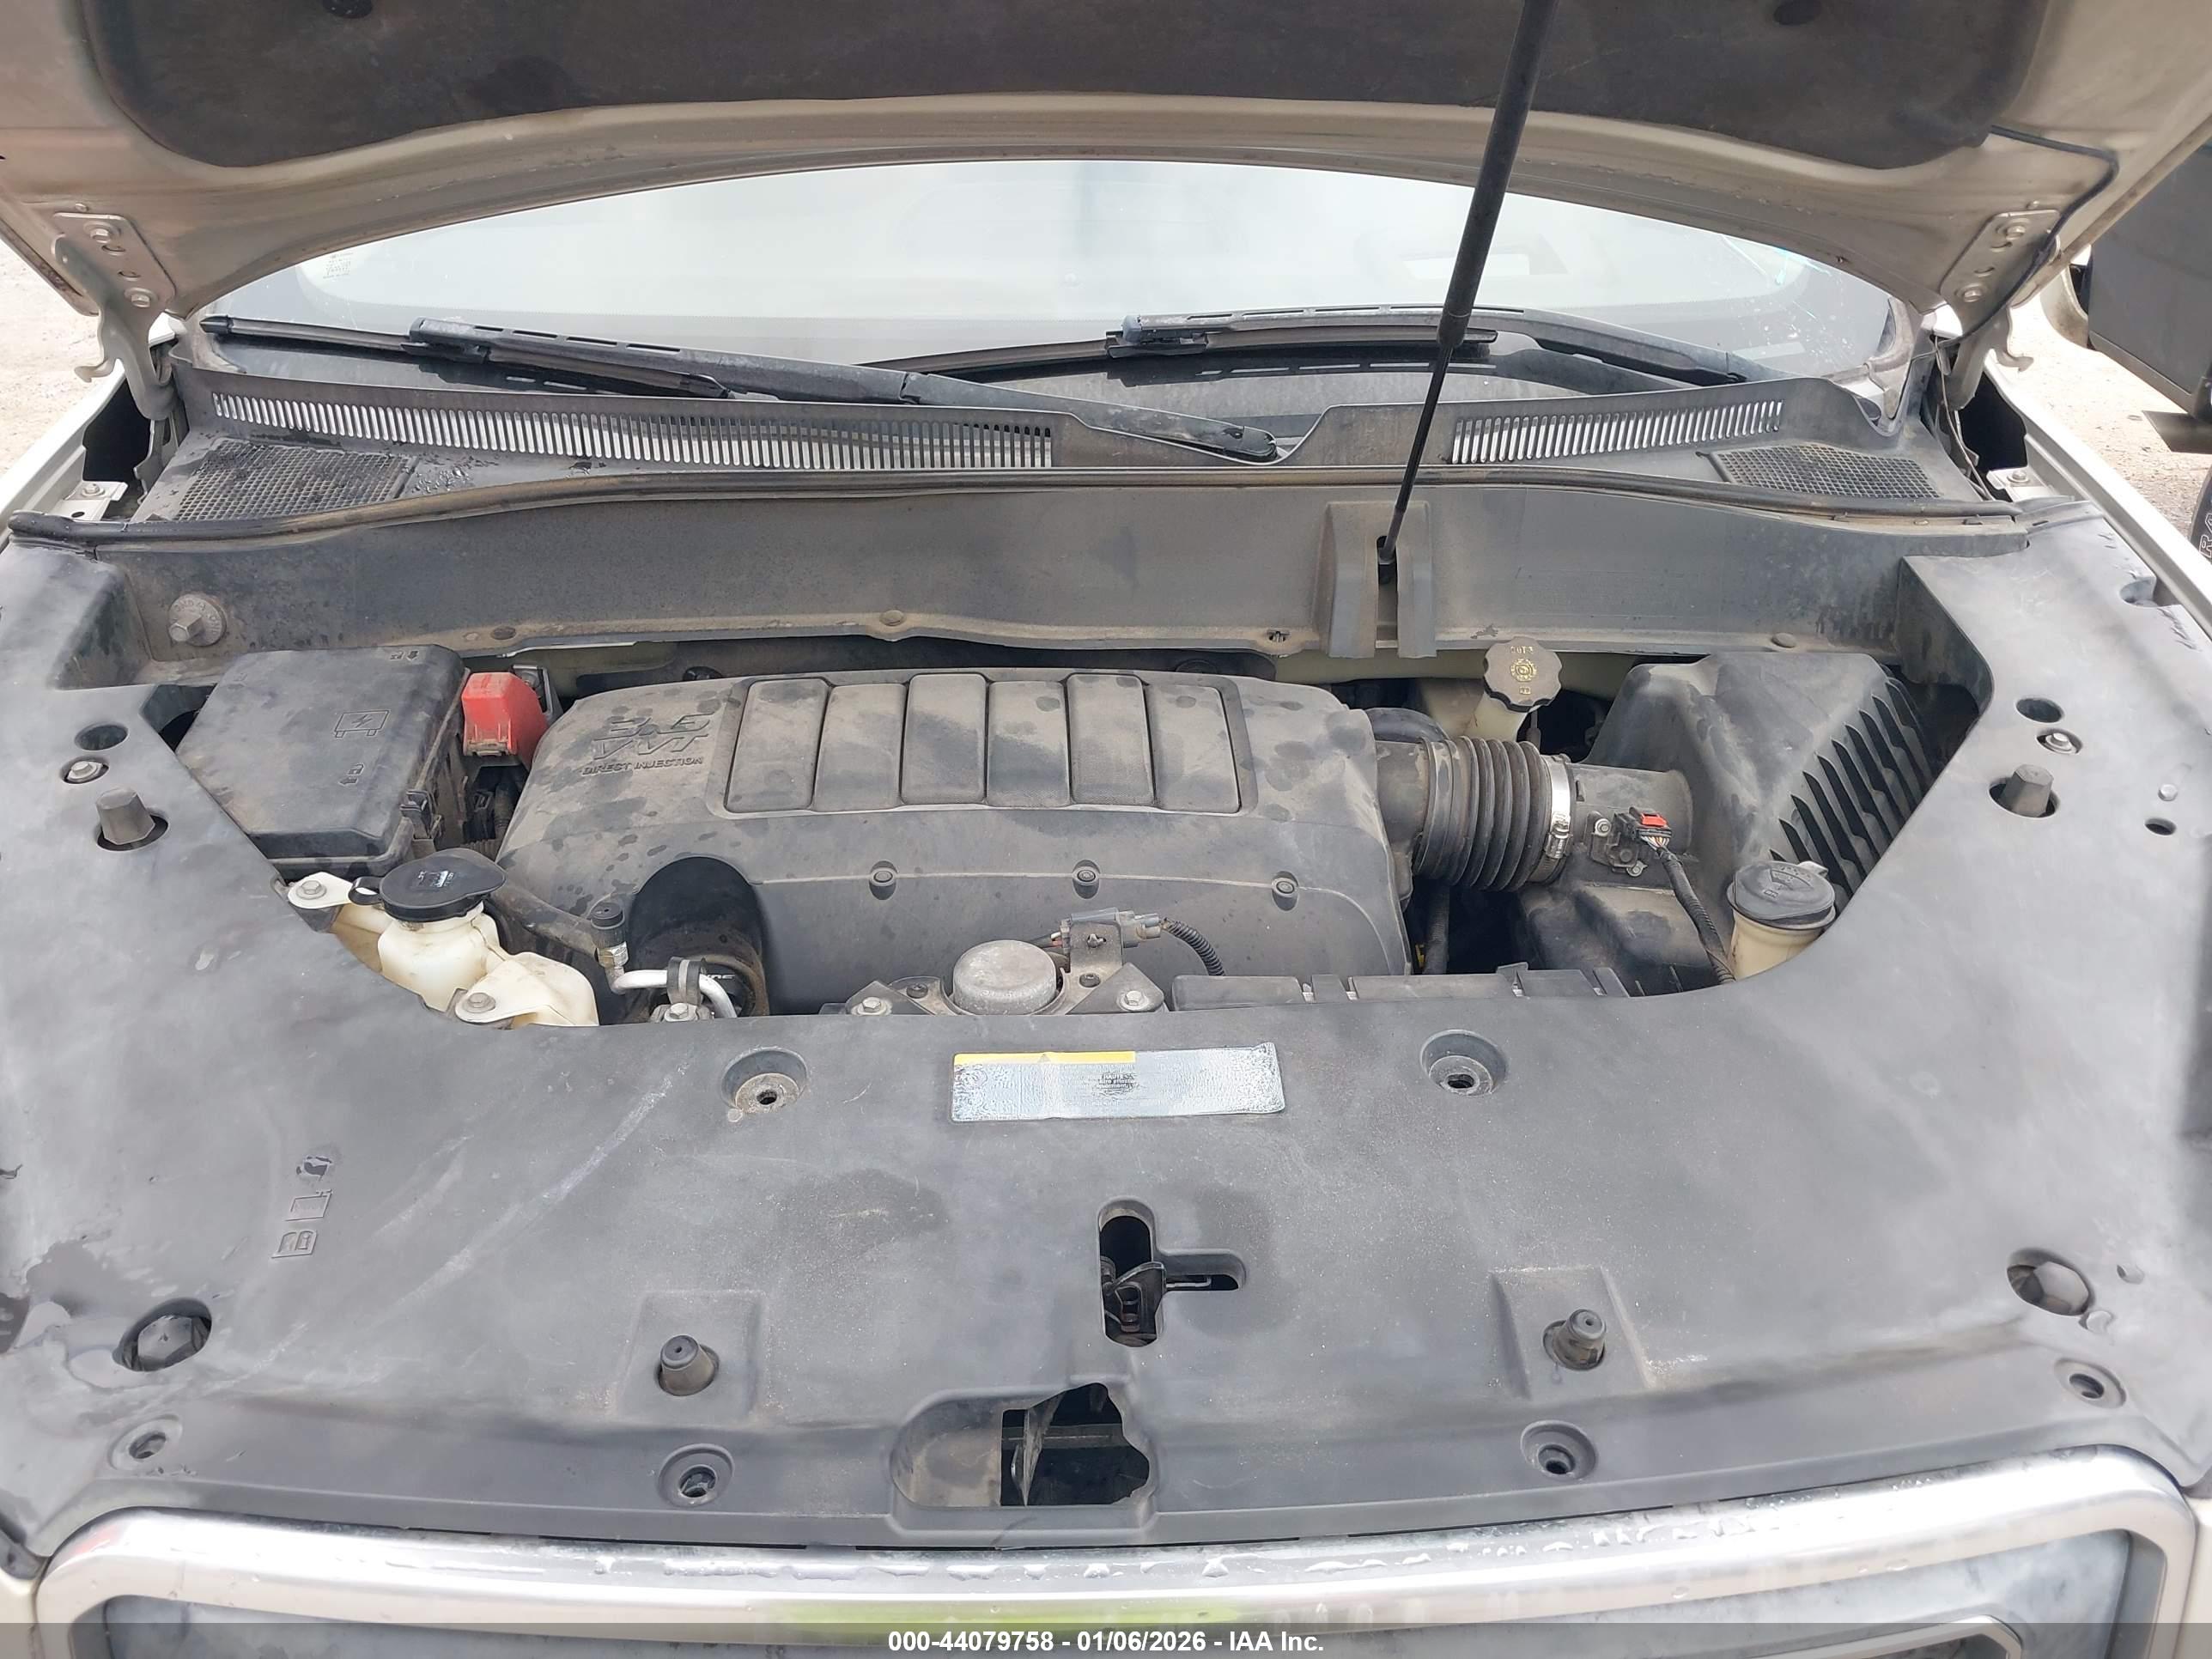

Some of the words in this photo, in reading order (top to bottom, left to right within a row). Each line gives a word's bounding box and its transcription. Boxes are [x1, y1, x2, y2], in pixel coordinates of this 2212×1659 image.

[592, 733, 709, 761] VVT
[580, 761, 632, 776] DIRECT
[633, 757, 703, 770] INJECTION
